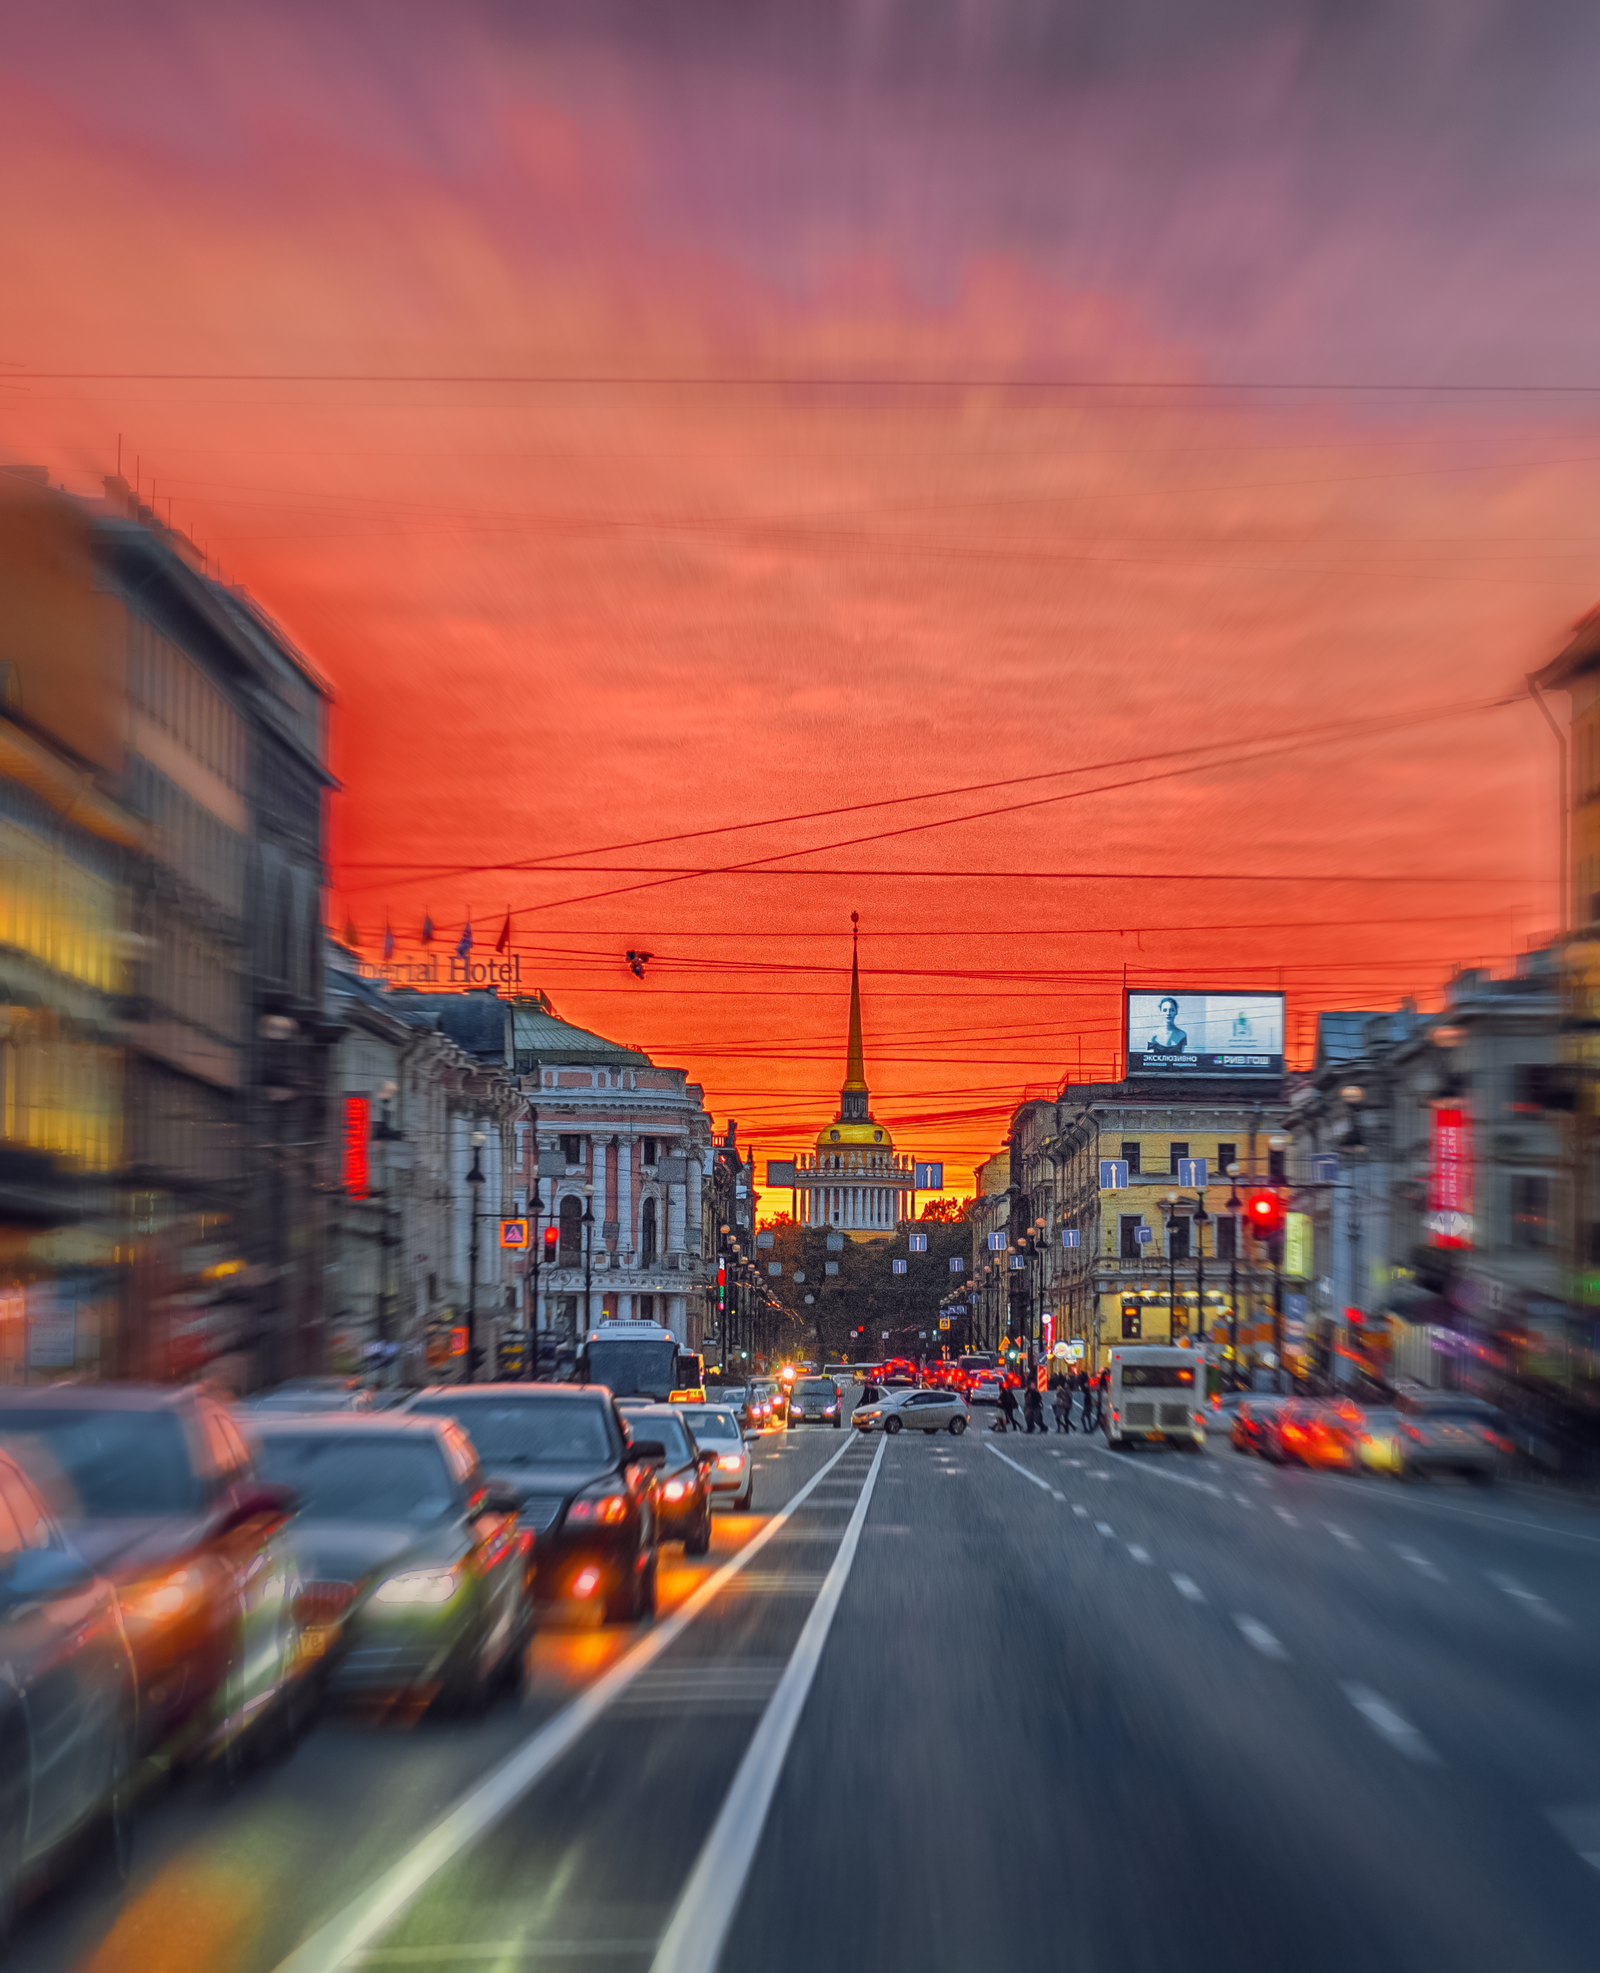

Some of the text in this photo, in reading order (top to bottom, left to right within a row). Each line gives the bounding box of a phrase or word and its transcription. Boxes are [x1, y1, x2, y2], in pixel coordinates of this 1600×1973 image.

[448, 954, 521, 982] Hotel
[1223, 1056, 1269, 1064] РИВ ГОШ
